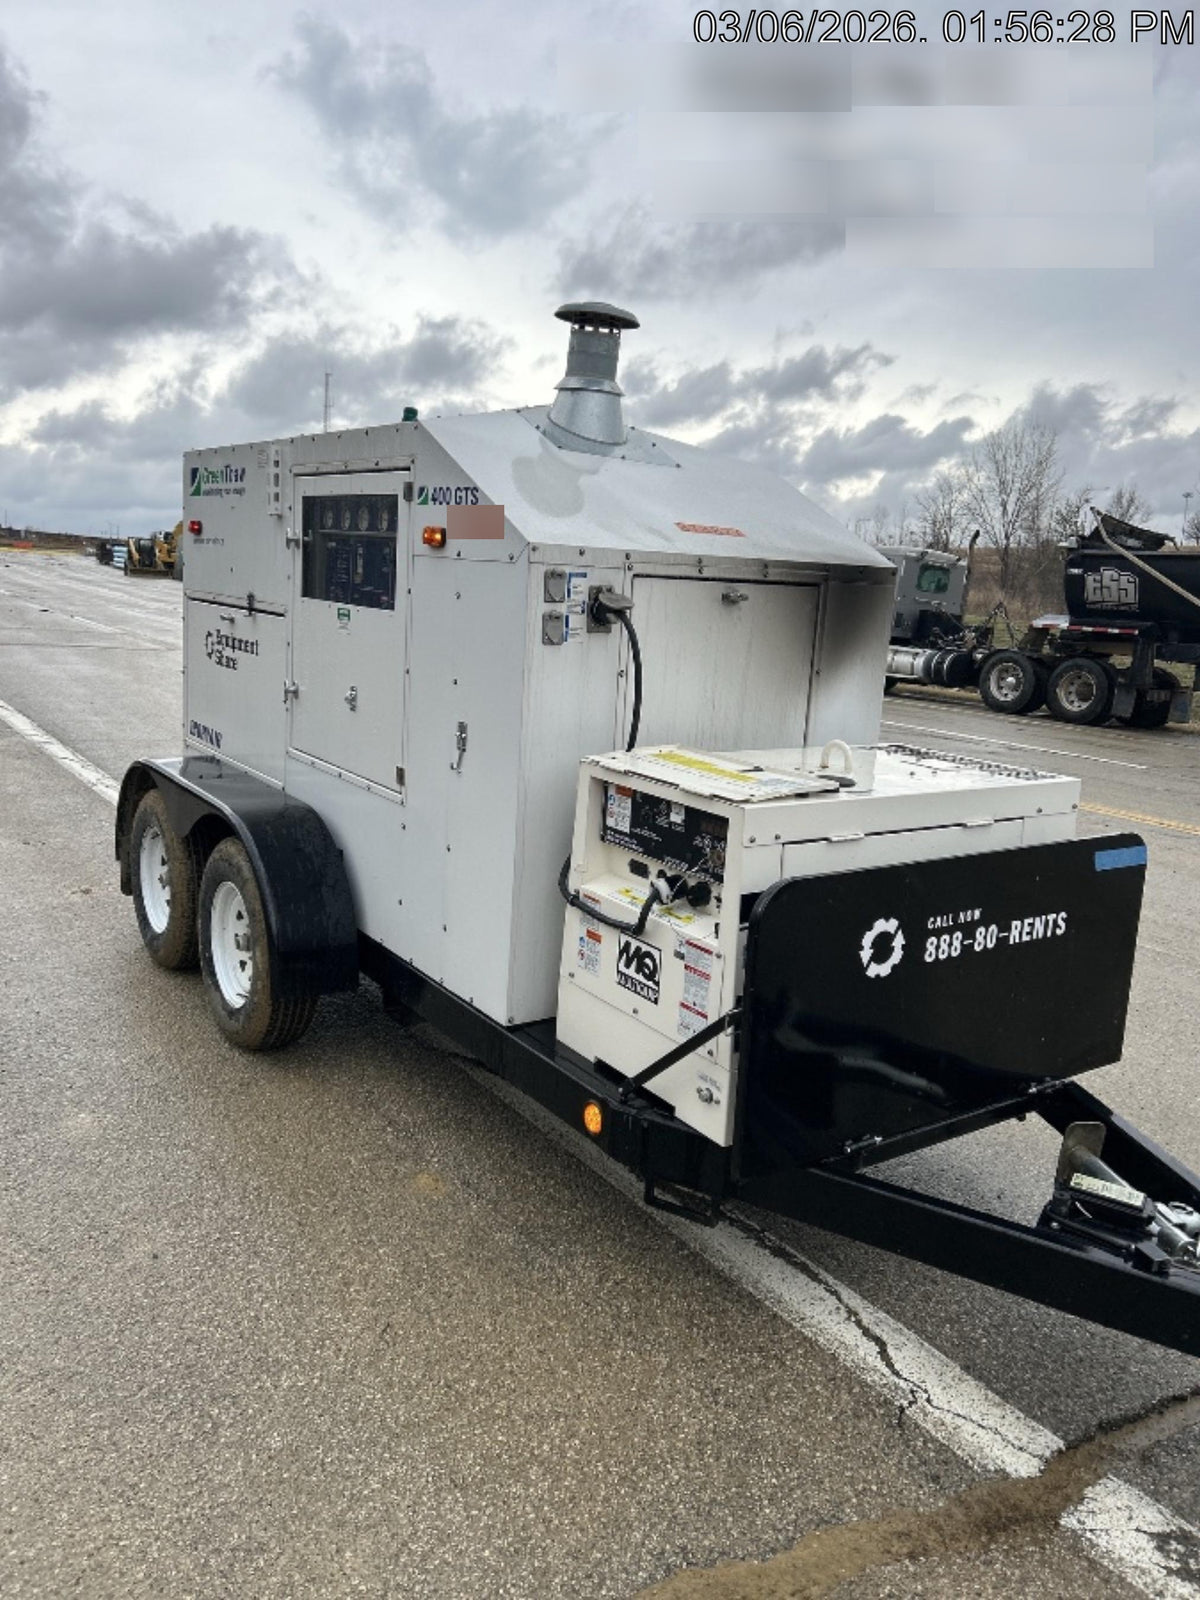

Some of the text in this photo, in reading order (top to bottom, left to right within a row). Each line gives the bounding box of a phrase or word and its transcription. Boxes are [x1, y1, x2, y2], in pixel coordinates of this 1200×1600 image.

[431, 486, 479, 506] 400 GTS
[927, 908, 983, 929] CALL NOW
[924, 911, 1068, 963] 888-80-RENTS
